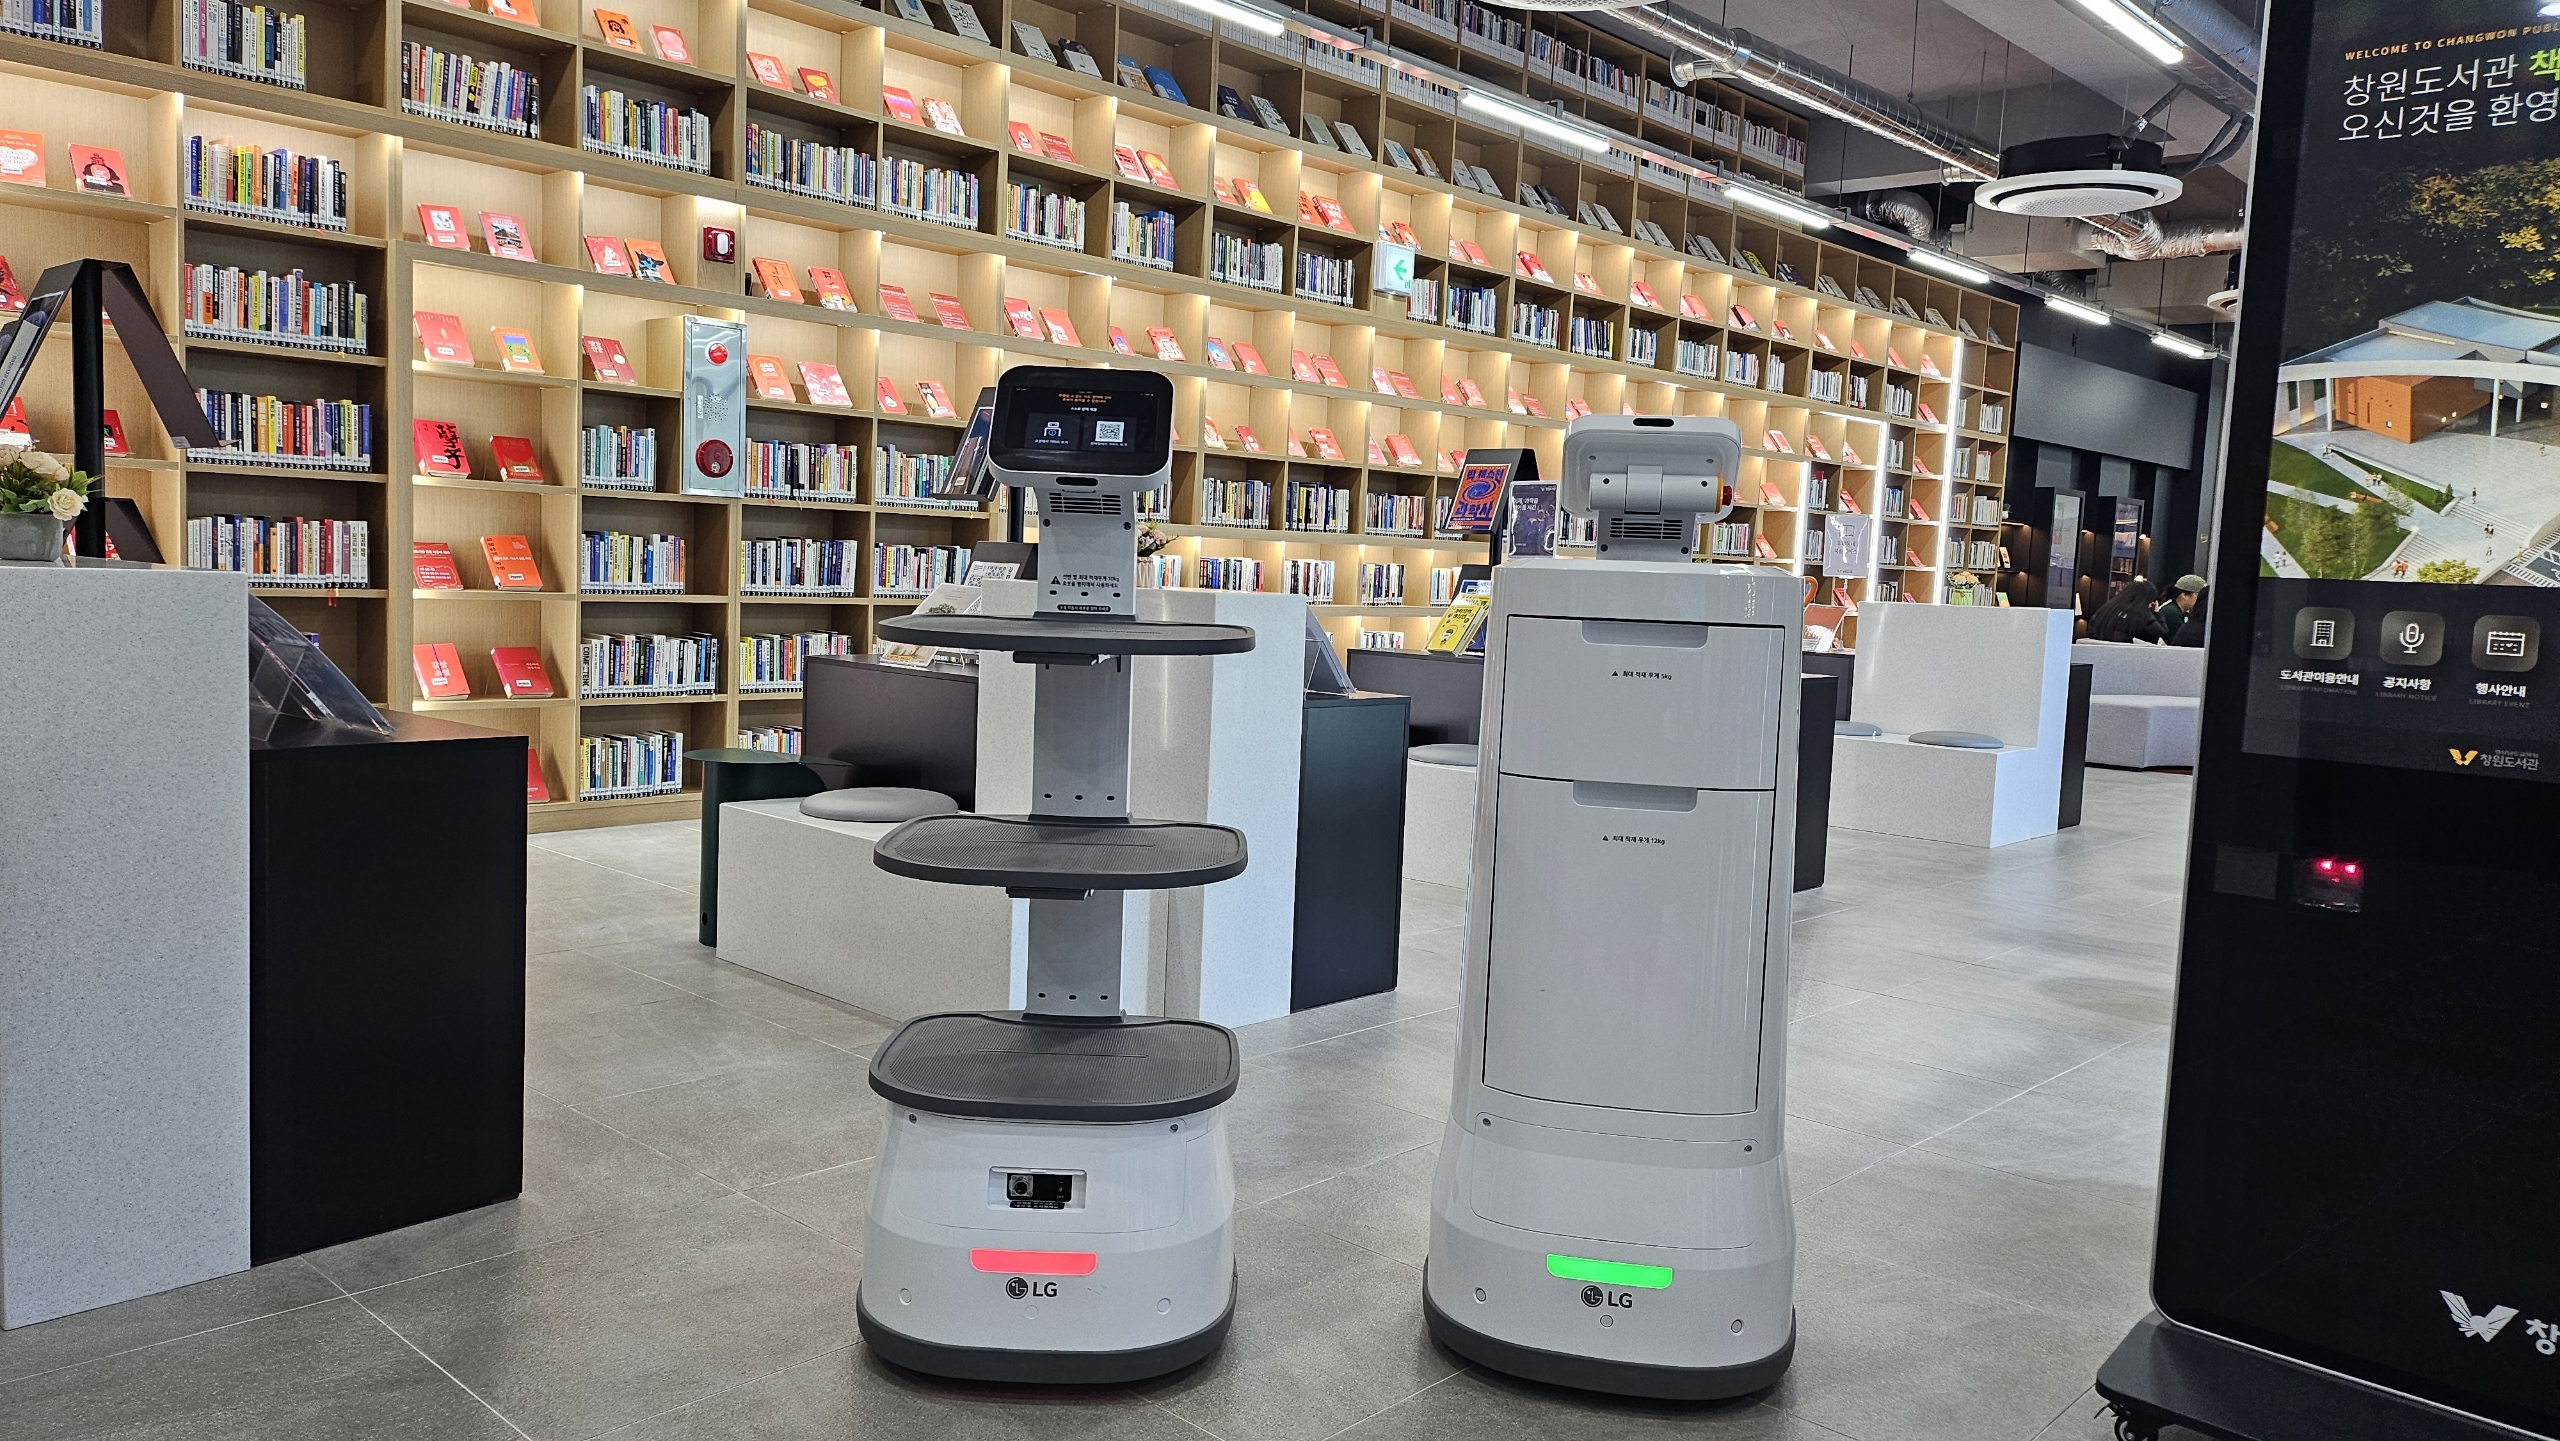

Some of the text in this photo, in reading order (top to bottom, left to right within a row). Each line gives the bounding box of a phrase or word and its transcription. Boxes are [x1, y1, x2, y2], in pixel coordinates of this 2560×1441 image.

[2345, 44, 2409, 61] WELCOME
[2414, 40, 2432, 51] TO
[2437, 28, 2517, 48] CHANGWON
[2343, 53, 2519, 107] 창원도서관
[2338, 98, 2478, 141] 오신것을
[1622, 670, 1634, 678] 최대
[1661, 673, 1672, 681] 5kg
[2279, 669, 2360, 686] 도서관이용안내
[2382, 676, 2432, 691] 공지사항
[2475, 682, 2527, 698] 행사안내
[2469, 698, 2531, 709] LIBRARY EVENT
[2479, 753, 2540, 771] 창원도서관
[1613, 835, 1666, 846] 최대 적재 무게 12kg
[1032, 1281, 1058, 1298] LG
[1607, 1290, 1633, 1309] LG
[2525, 1318, 2560, 1356] 창
